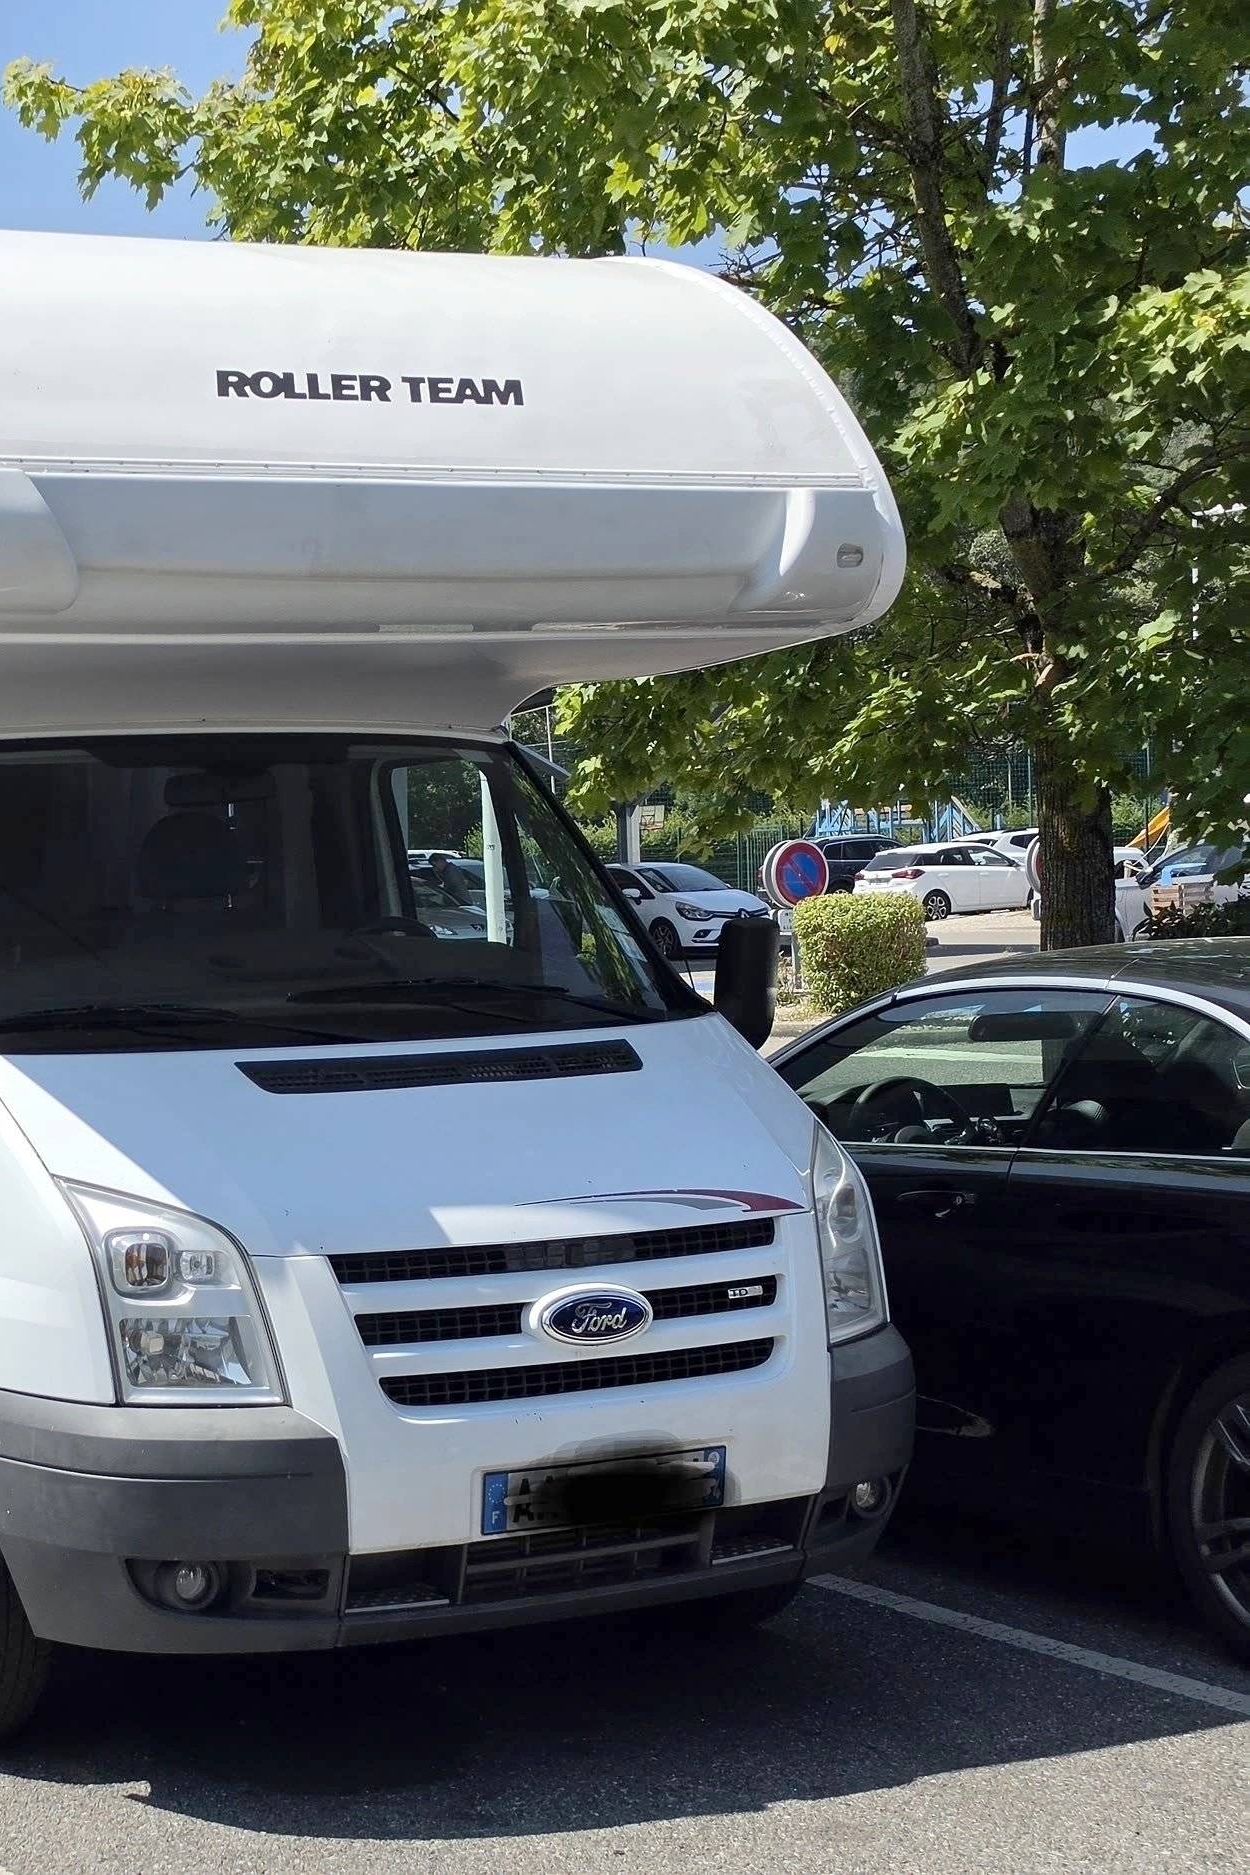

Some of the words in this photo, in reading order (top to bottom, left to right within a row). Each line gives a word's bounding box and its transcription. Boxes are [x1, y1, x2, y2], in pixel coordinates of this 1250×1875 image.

[216, 369, 392, 403] ROLLER
[401, 376, 525, 406] TEAM
[571, 1301, 628, 1334] Ford
[491, 1511, 500, 1525] F
